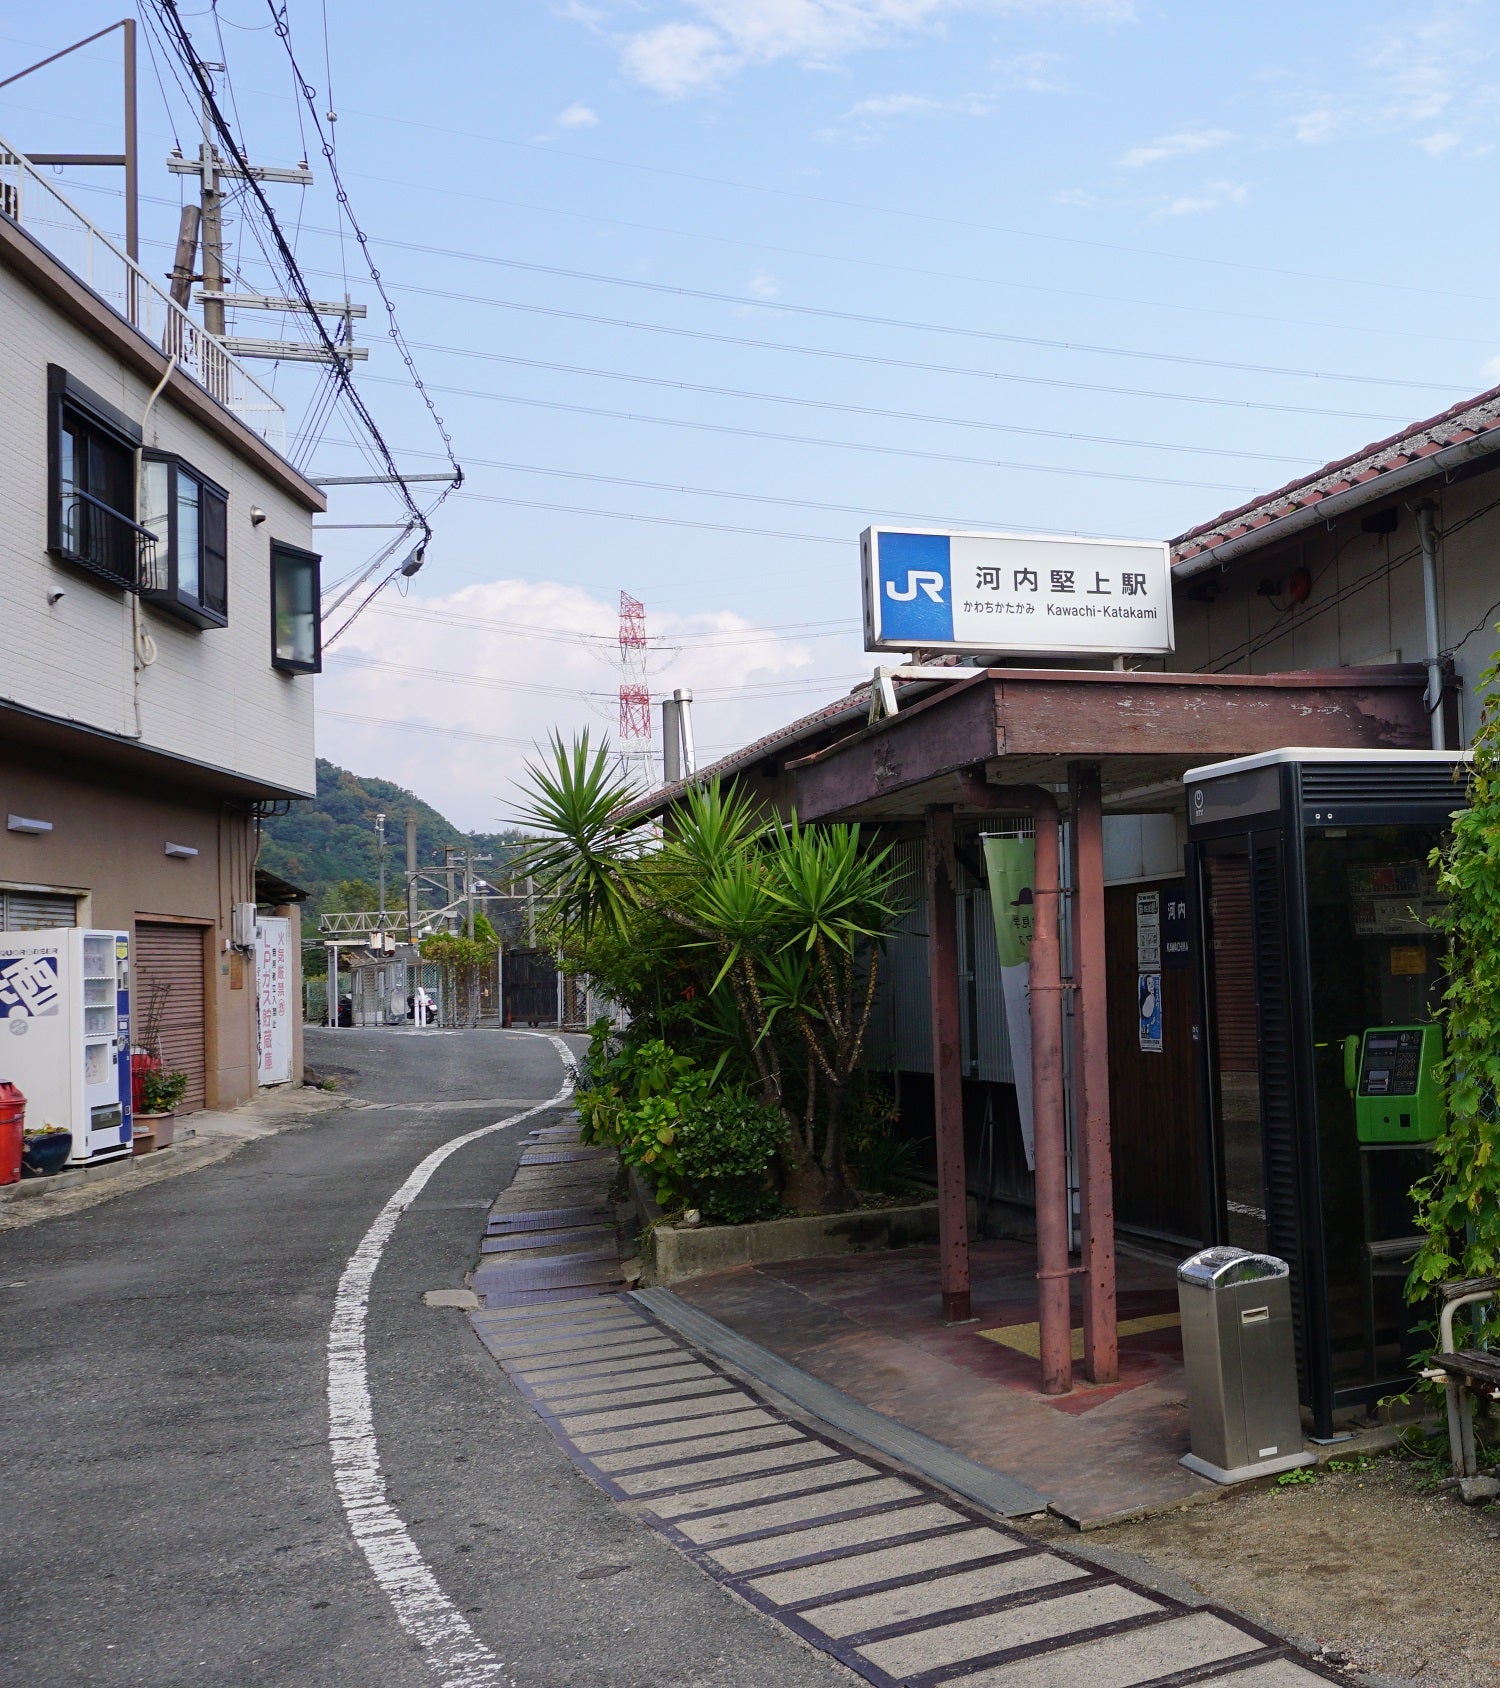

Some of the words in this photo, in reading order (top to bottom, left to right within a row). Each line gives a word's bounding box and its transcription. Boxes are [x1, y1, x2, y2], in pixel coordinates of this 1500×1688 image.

[886, 570, 945, 603] JR
[975, 565, 1148, 596] 河内堅上駅
[963, 600, 1035, 615] かわちかたかみ
[1047, 603, 1157, 619] Kawachi-Katakami
